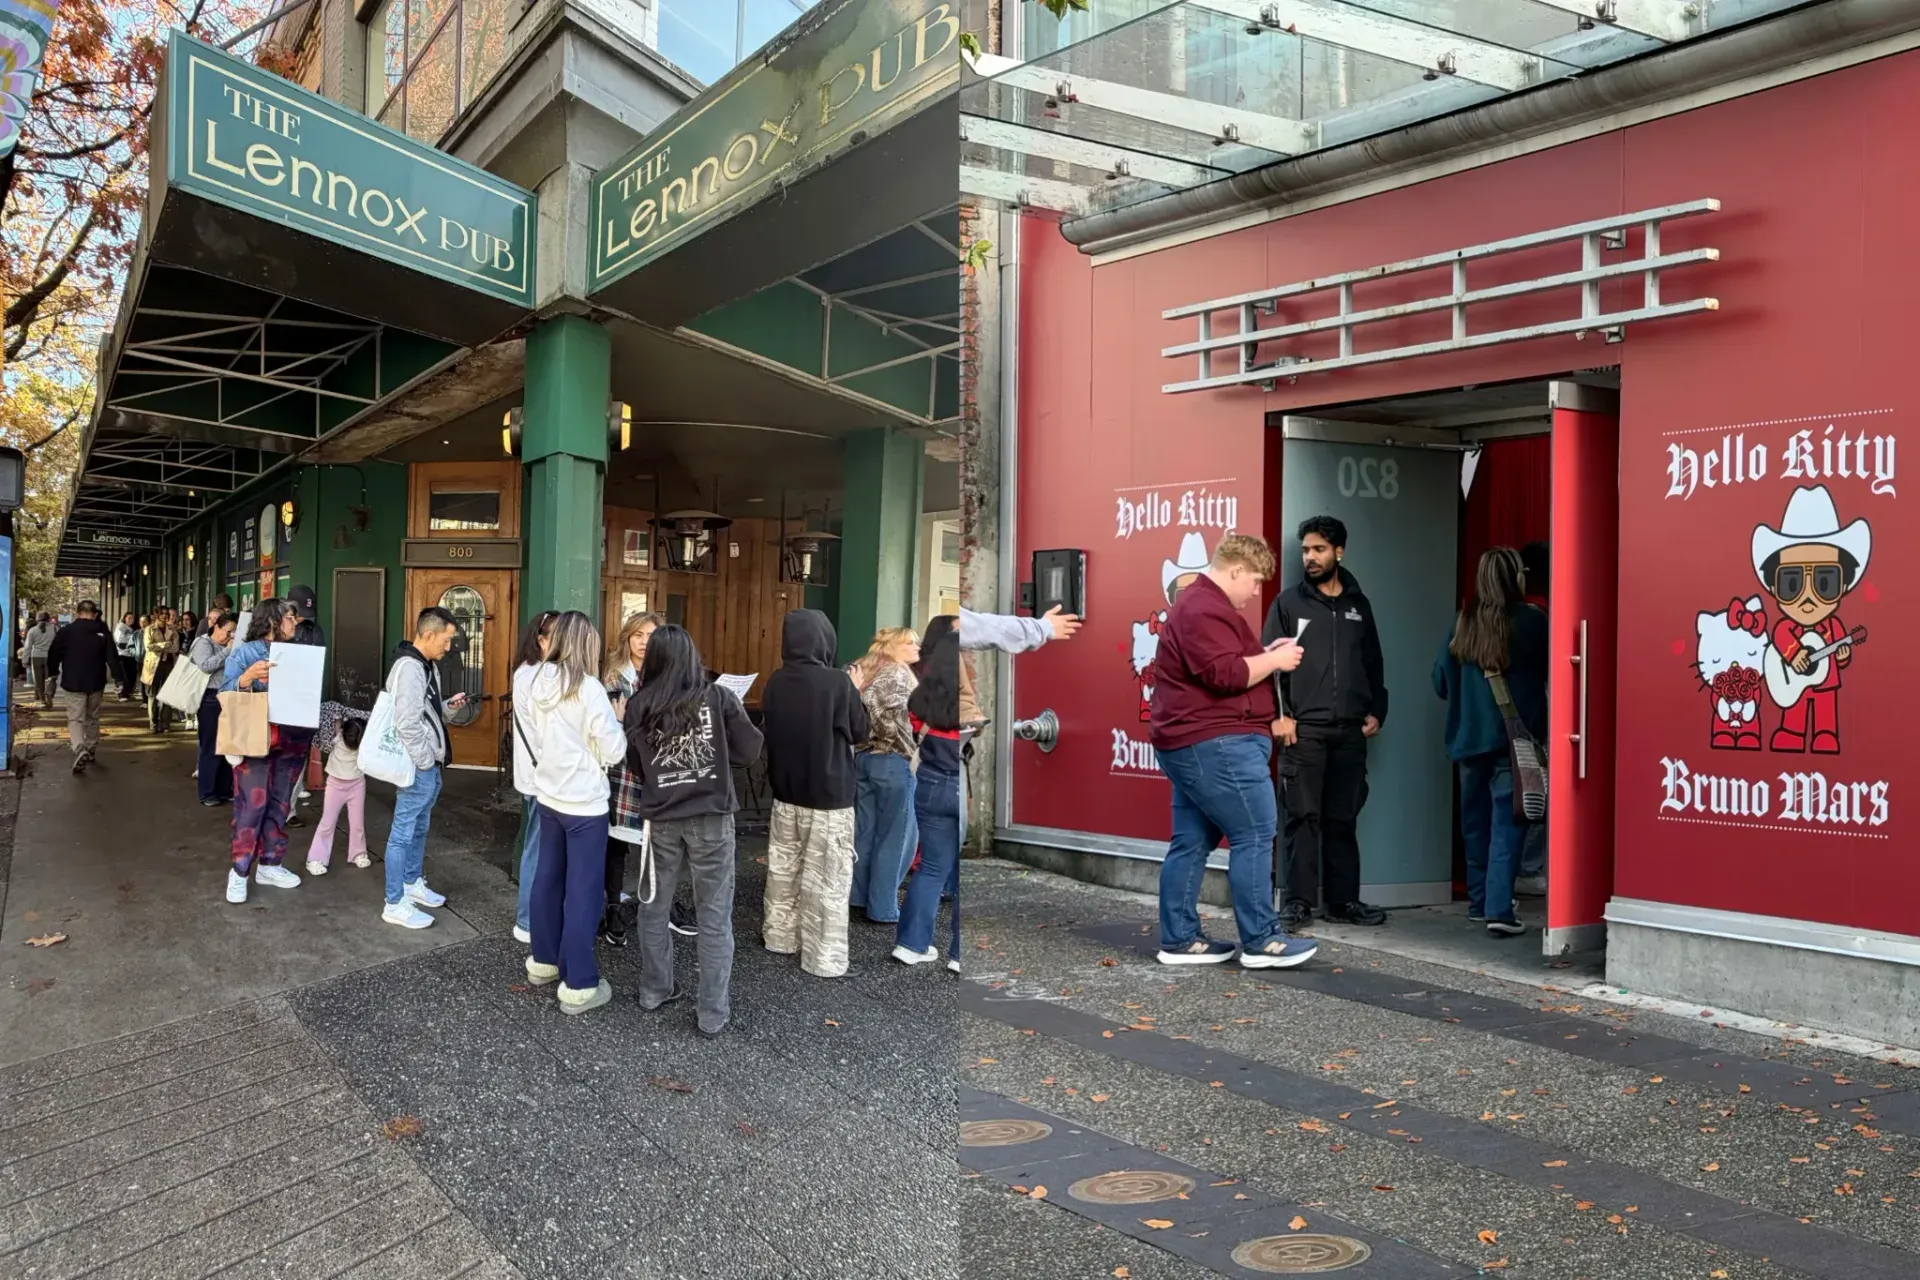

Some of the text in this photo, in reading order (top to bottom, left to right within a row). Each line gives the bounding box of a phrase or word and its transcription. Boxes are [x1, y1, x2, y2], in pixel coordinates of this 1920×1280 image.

[223, 83, 301, 145] THE
[606, 2, 960, 258] Lennox PUB
[206, 119, 516, 273] Lennox PUB
[618, 145, 671, 202] THE
[1664, 423, 1897, 501] Hello Kitty
[1114, 487, 1238, 541] Hello Kitty
[449, 547, 473, 557] 800
[1110, 727, 1161, 771] Brun
[1659, 756, 1890, 827] Bruno Mars
